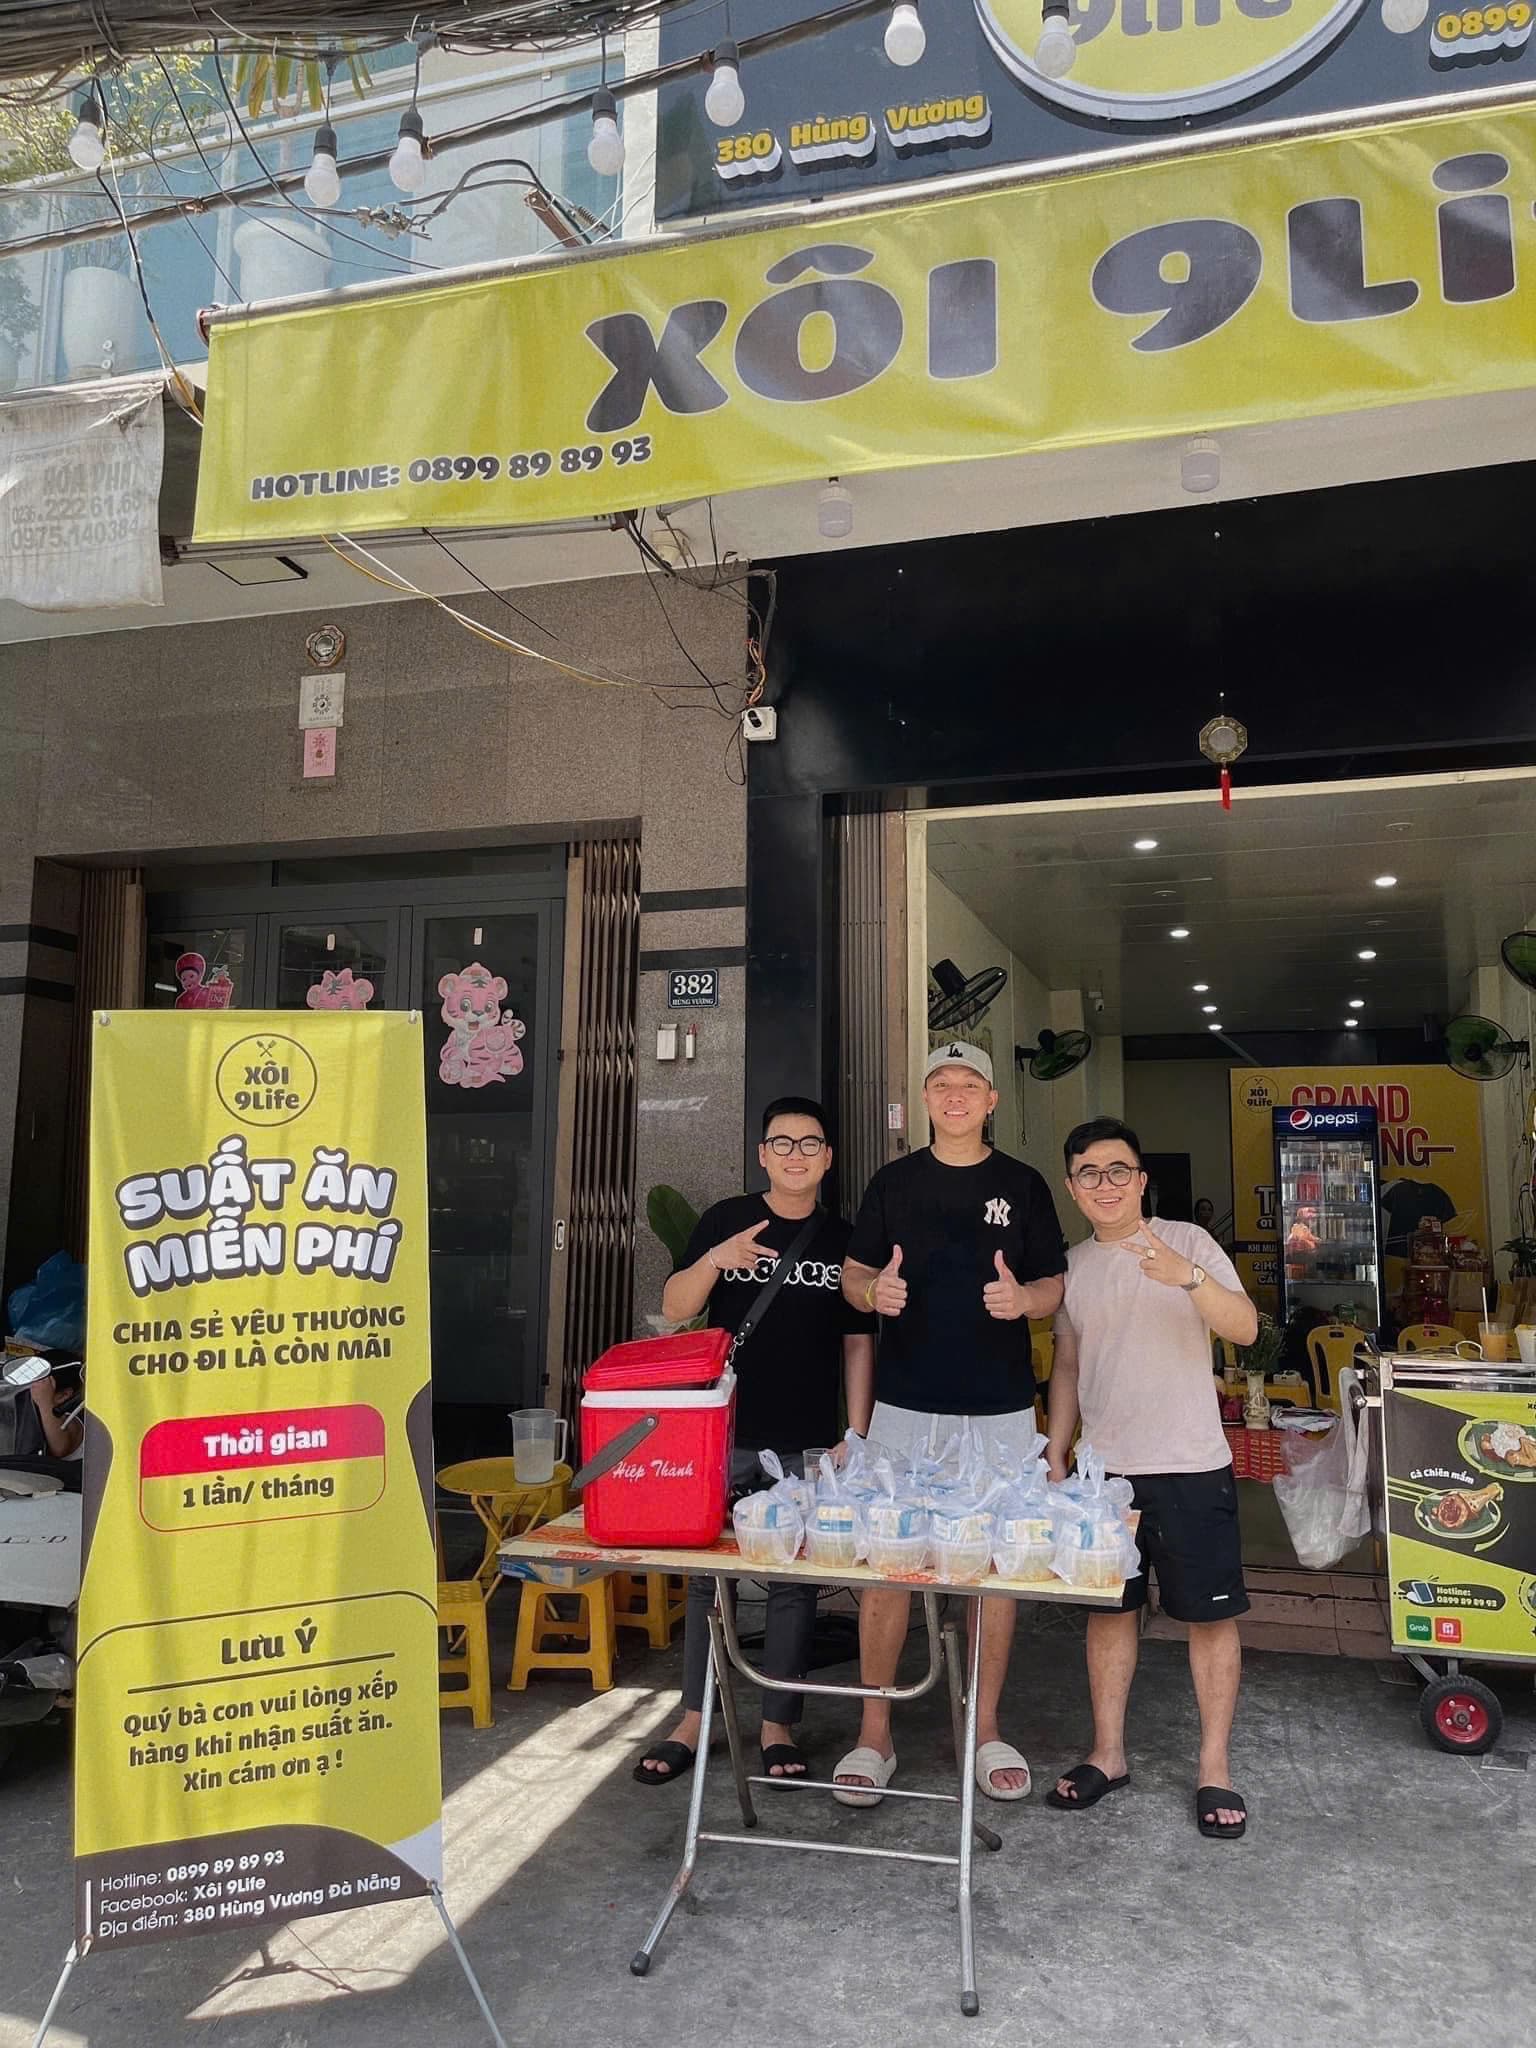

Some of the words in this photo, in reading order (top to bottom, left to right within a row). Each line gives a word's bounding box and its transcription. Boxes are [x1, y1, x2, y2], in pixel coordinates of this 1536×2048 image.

[1437, 3, 1532, 40] 0899
[717, 132, 773, 163] 380
[886, 95, 985, 131] Vương
[584, 243, 1000, 434] XÔI
[1091, 151, 1536, 354] 9Li
[251, 464, 401, 500] HOTLINE:
[408, 455, 501, 483] 0899
[508, 451, 552, 479] 89
[560, 445, 603, 473] 89
[611, 436, 652, 467] 93
[674, 974, 713, 995] 382
[244, 1061, 289, 1084] XÔI
[234, 1090, 300, 1110] 9Life
[1314, 1112, 1358, 1127] pepsi
[117, 1135, 295, 1228] SUẤT
[303, 1147, 397, 1217] ĂN
[126, 1206, 284, 1296] MIỄN
[296, 1219, 402, 1282] PHÍ
[113, 1319, 182, 1344] CHIA
[190, 1309, 224, 1339] SẺ
[231, 1309, 285, 1337] YÊU
[293, 1305, 406, 1333] THƯƠNG
[128, 1353, 189, 1376] CHO
[194, 1349, 226, 1371] ĐI
[235, 1339, 269, 1368] LÀ
[274, 1336, 330, 1365] CÒN
[337, 1333, 391, 1360] MÃI
[203, 1428, 264, 1458] Thời
[270, 1425, 328, 1456] gian
[183, 1488, 197, 1508] 1
[203, 1475, 255, 1505] lần/
[262, 1474, 335, 1499] tháng
[1437, 1587, 1471, 1597] Hotline:
[221, 1634, 285, 1665] Lưu
[294, 1617, 319, 1653] Ý
[1409, 1623, 1429, 1633] Grab
[124, 1708, 172, 1739] Quý
[178, 1702, 207, 1727] bà
[213, 1700, 253, 1723] con
[260, 1688, 297, 1715] vui
[302, 1684, 352, 1709] lòng
[357, 1669, 398, 1700] xếp
[130, 1740, 188, 1767] hàng
[195, 1732, 232, 1757] khi
[238, 1724, 296, 1751] nhận
[302, 1708, 352, 1741] suất
[358, 1709, 393, 1733] ăn.
[229, 1760, 276, 1785] cám
[282, 1754, 310, 1776] ơn
[101, 1870, 161, 1892] Hotline:
[167, 1862, 208, 1882] 0899
[213, 1858, 235, 1875] 89
[238, 1854, 260, 1871] 89
[263, 1850, 285, 1866] 93
[99, 1916, 128, 1938] Địa
[132, 1909, 179, 1933] điểm:
[184, 1907, 215, 1924] 380
[219, 1898, 265, 1920] Hùng
[269, 1888, 324, 1911] Vương
[329, 1881, 352, 1898] Đà
[101, 1889, 189, 1915] Facebook:
[194, 1881, 222, 1901] Xôi
[227, 1876, 266, 1896] 9Life
